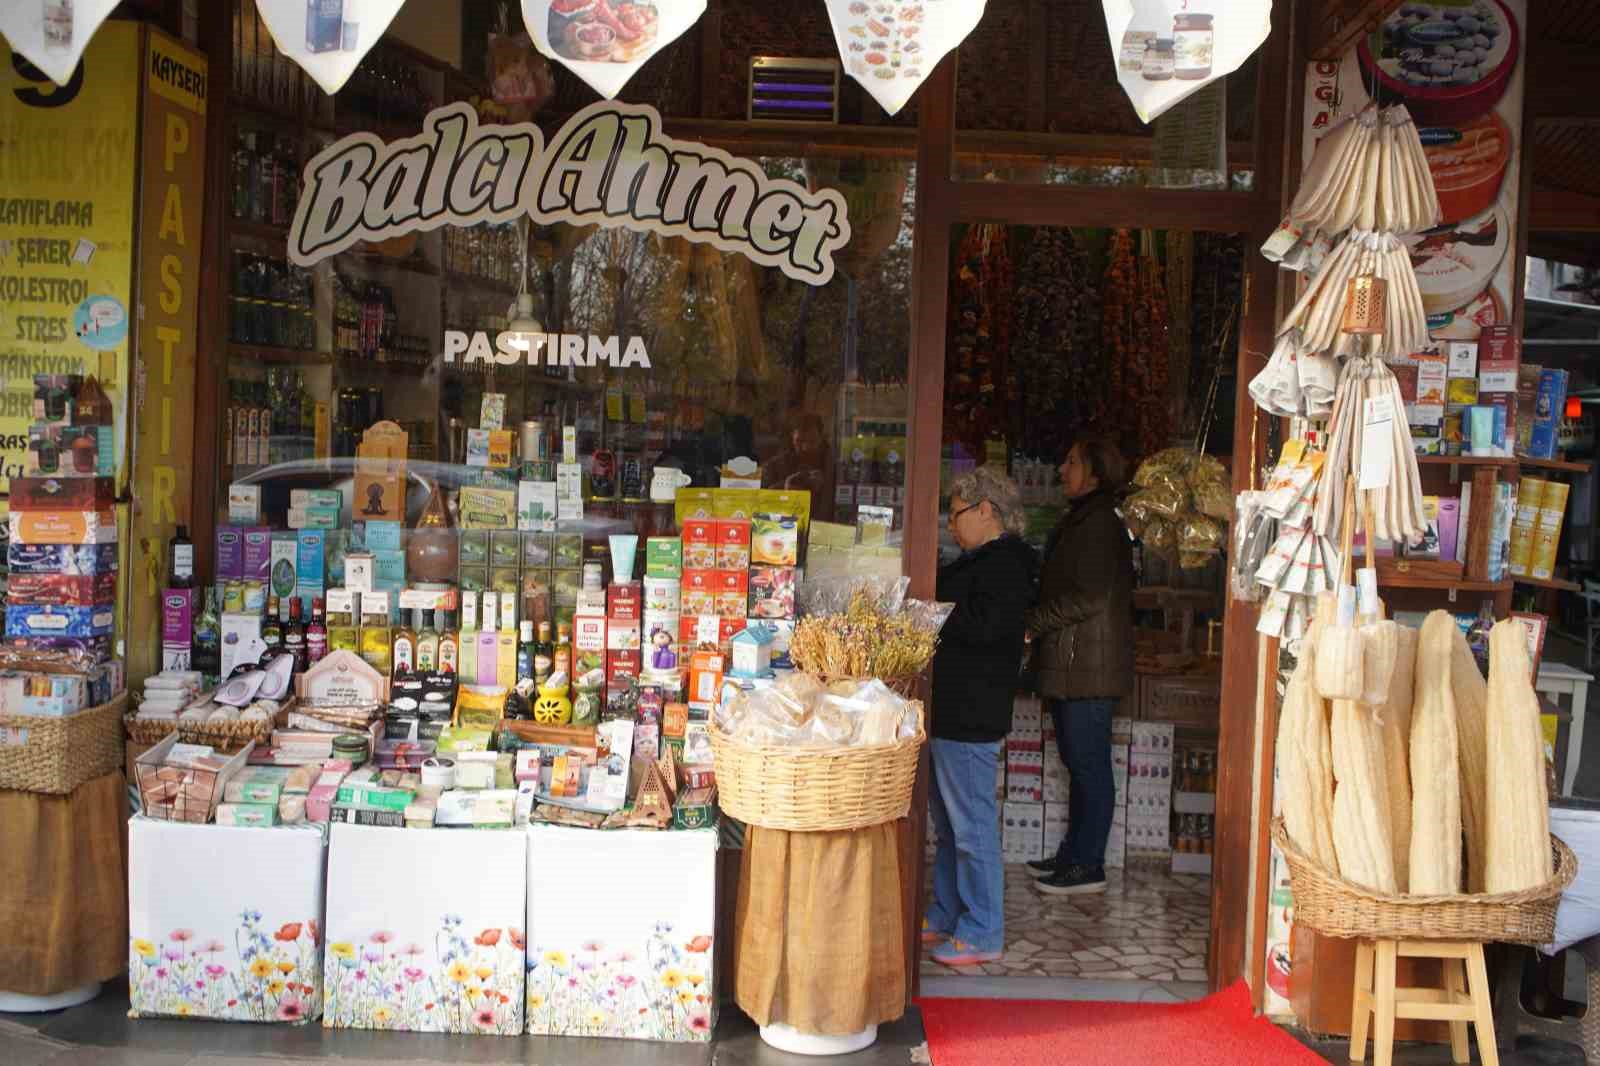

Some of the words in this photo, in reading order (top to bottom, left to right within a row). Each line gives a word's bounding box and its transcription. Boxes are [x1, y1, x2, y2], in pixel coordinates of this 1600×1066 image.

[299, 111, 535, 257] Balcı
[536, 108, 838, 275] Ahmet
[16, 237, 71, 269] ŞEKER
[16, 315, 67, 344] STRES
[445, 330, 652, 369] PASTIRMA
